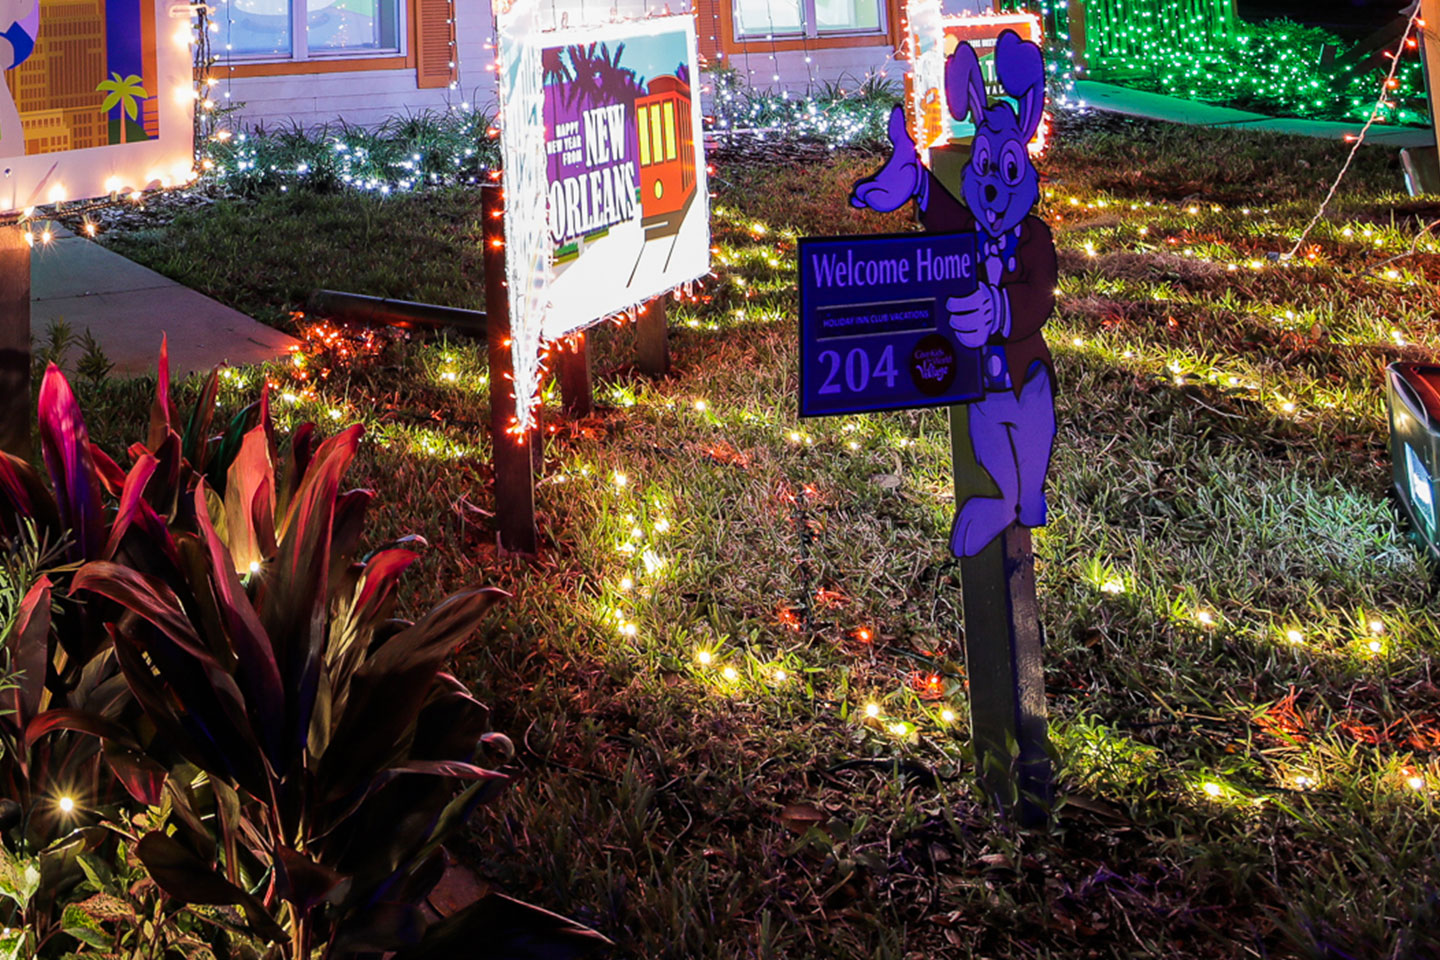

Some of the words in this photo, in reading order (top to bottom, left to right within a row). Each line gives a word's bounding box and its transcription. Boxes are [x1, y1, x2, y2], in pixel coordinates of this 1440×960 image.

[583, 104, 625, 167] NEW
[550, 162, 635, 240] ORLEANS
[812, 249, 910, 288] Welcome
[916, 248, 971, 282] Home
[823, 317, 854, 328] HOLIDAY
[871, 313, 889, 324] CLUB
[890, 309, 929, 321] VACATIONS
[818, 344, 899, 395] 204
